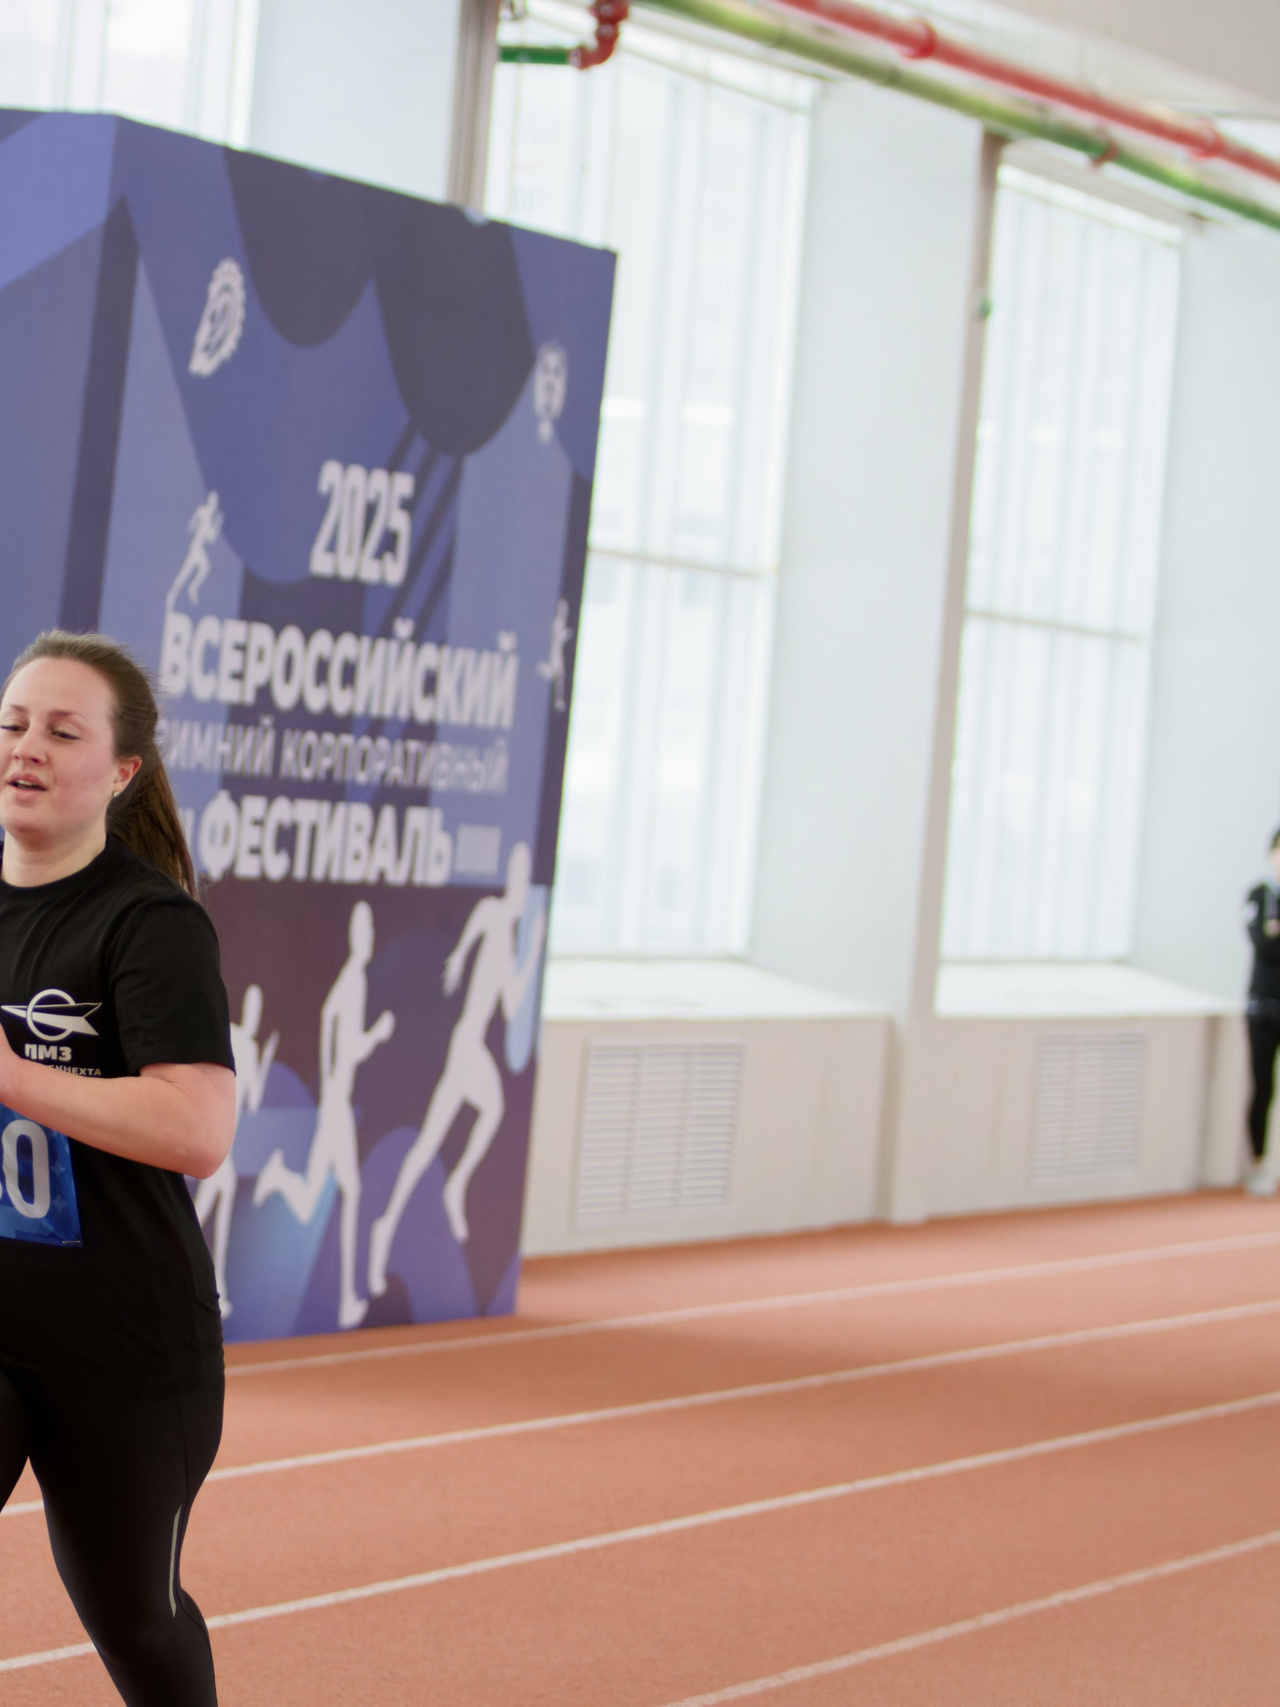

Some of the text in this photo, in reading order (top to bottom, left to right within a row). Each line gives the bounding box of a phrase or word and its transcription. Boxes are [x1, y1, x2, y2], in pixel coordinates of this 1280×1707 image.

[309, 459, 415, 587] 2025
[158, 611, 519, 729] ВСЕРОССИЙСКИЙ
[280, 727, 511, 795] КОРПОРАТИВНЫЙ
[198, 788, 454, 888] ФЕСТИВАЛЬ
[24, 1043, 72, 1062] ПМЗ
